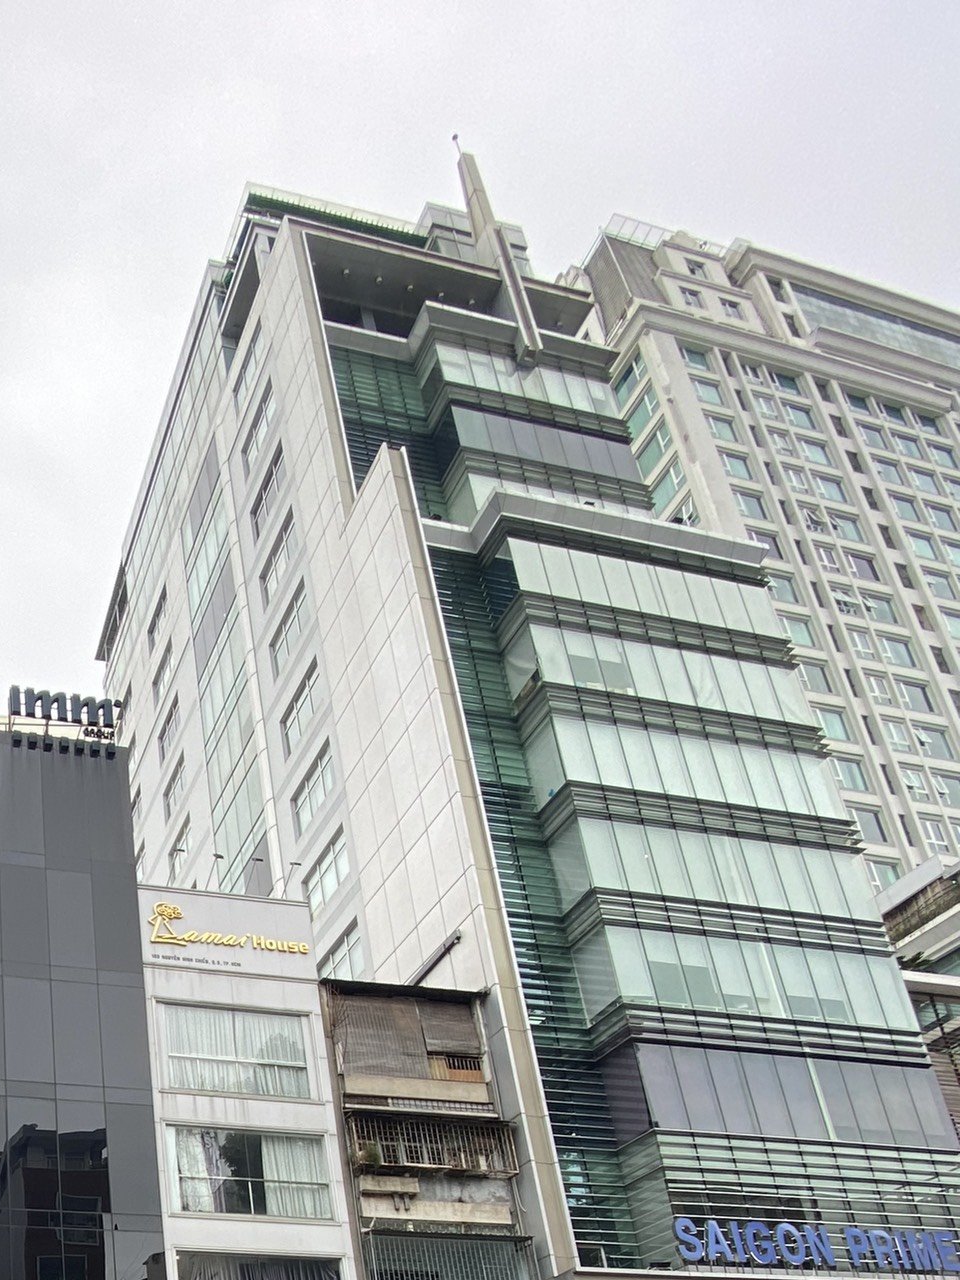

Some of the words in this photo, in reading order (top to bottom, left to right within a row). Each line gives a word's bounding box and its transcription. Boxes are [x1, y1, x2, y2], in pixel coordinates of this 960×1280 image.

[252, 934, 310, 955] House
[673, 1217, 837, 1268] SAIGON
[843, 1227, 960, 1272] PRIME
